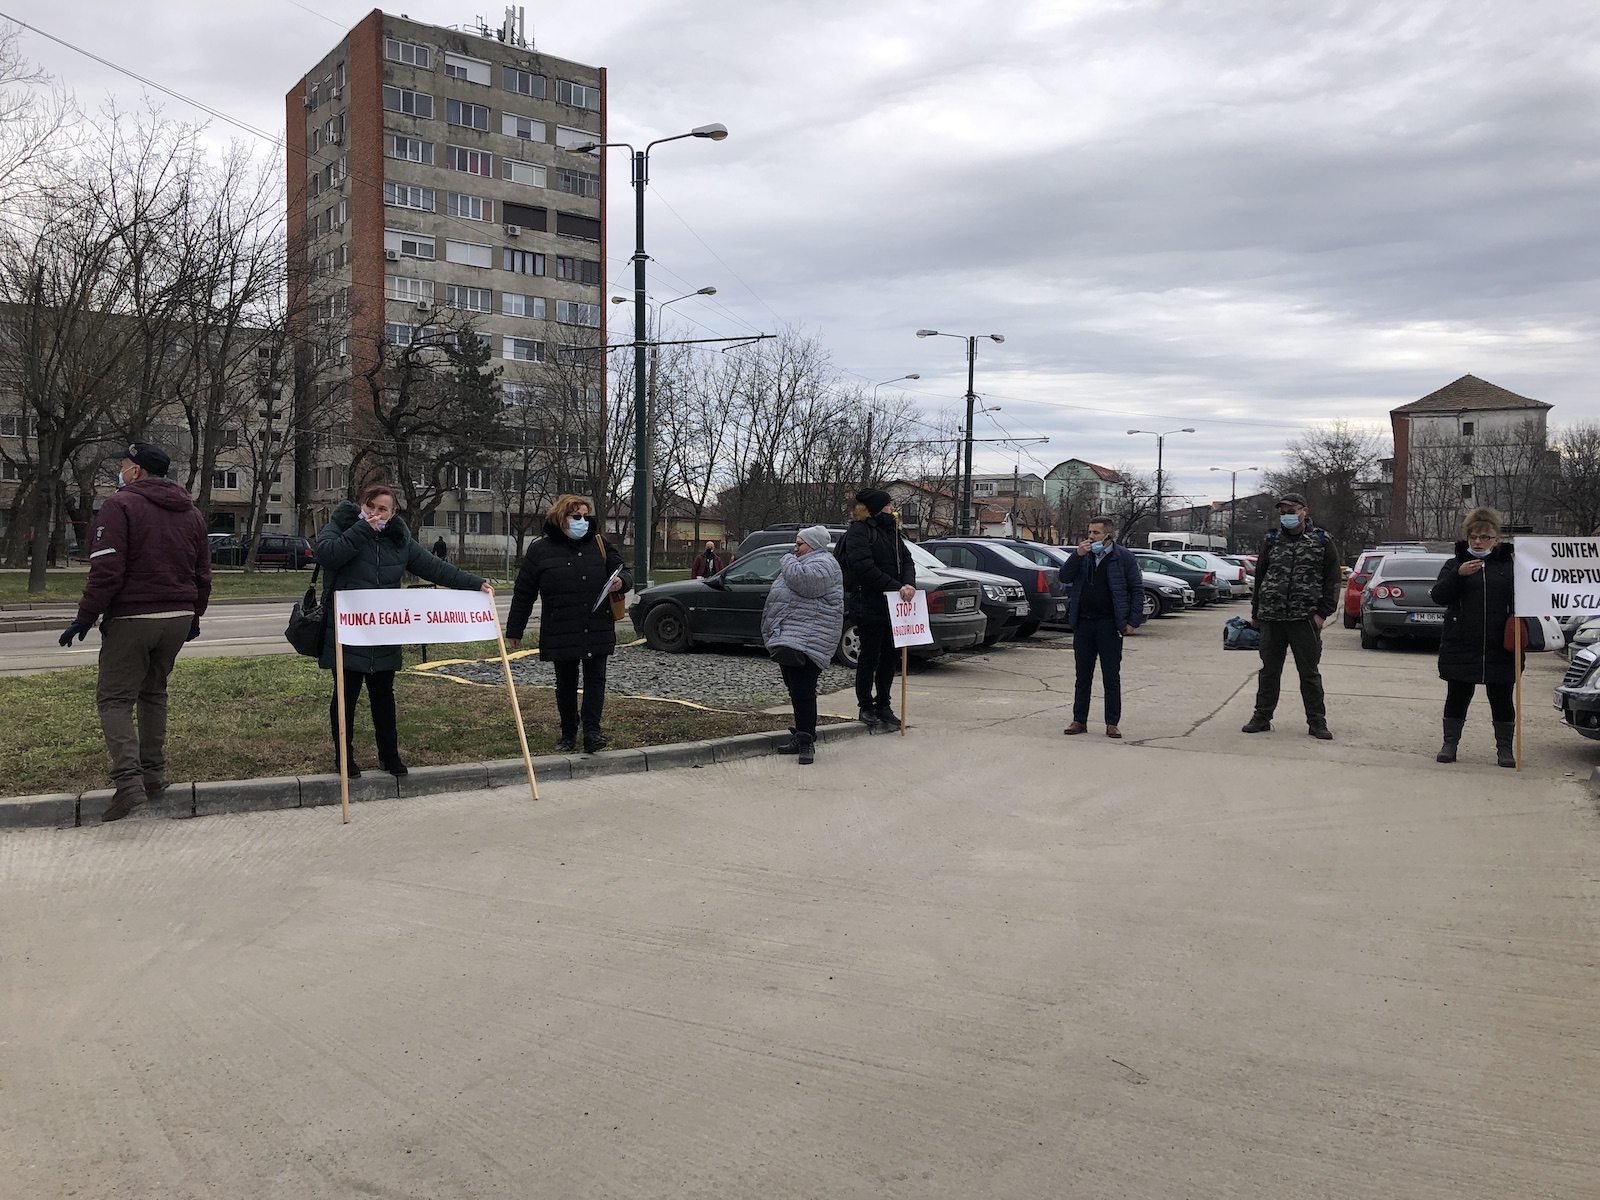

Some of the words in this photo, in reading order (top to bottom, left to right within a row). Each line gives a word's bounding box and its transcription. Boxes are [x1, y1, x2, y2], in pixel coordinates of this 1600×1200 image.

[1551, 542, 1599, 558] SUNTEM
[1531, 568, 1549, 583] CU
[1551, 568, 1600, 584] DREPTU
[1551, 593, 1570, 609] NU
[339, 612, 376, 626] MUNCA
[379, 608, 411, 625] EGALĂ
[426, 610, 469, 624] SALARIUL
[470, 610, 494, 623] EGAL
[894, 623, 926, 637] ABUZURILOR
